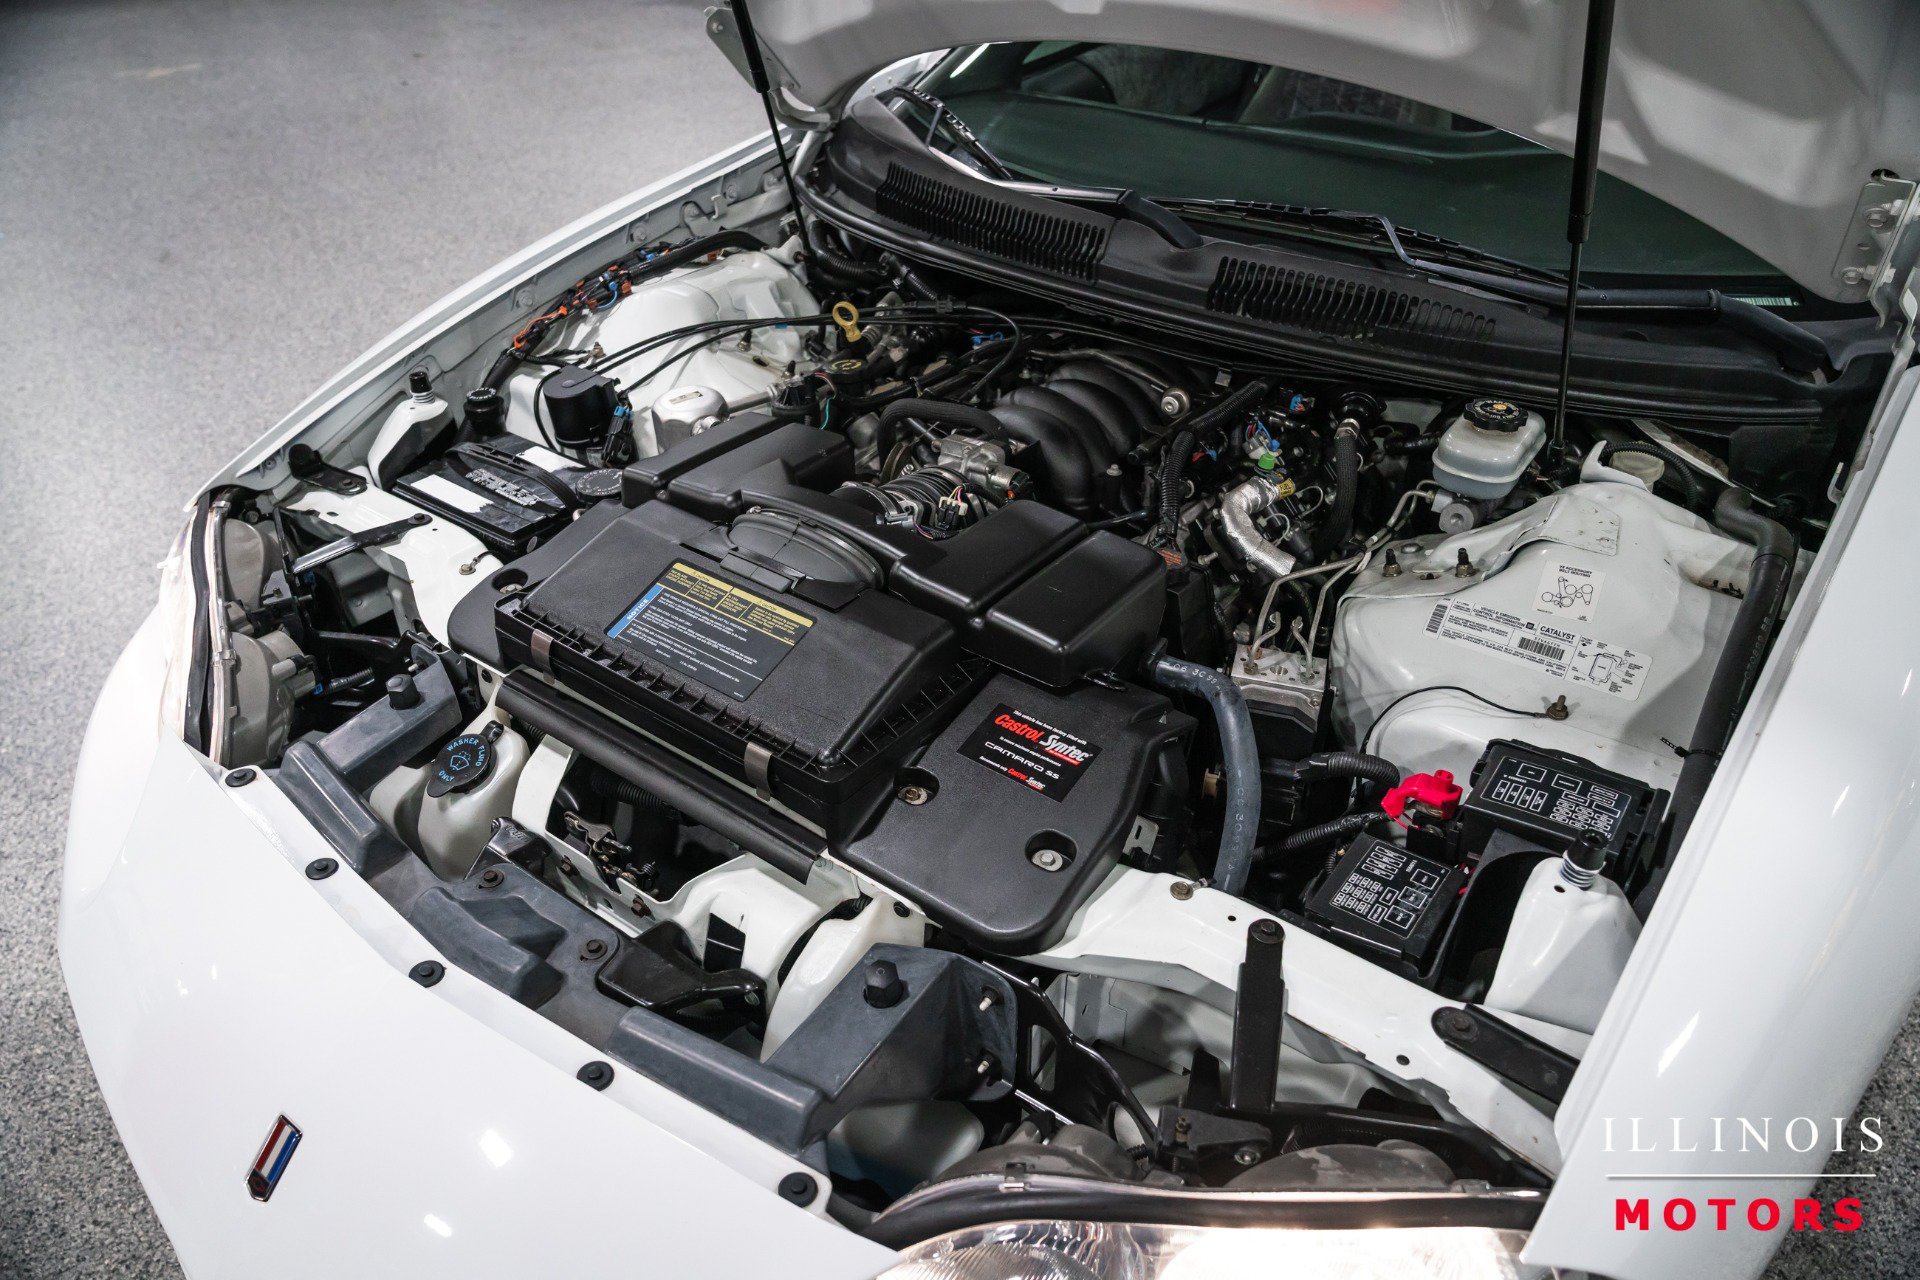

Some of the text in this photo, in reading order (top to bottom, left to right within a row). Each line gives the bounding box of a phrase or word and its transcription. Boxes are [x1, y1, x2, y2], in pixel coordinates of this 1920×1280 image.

[627, 599, 648, 620] NOTICE
[1472, 608, 1525, 627] CONTROL INFORMATION
[1480, 606, 1499, 615] VEHICLE
[1499, 612, 1521, 622] EMISSION
[1540, 626, 1576, 641] CATALYST
[1022, 714, 1036, 722] vehicle
[1052, 728, 1067, 737] factory
[447, 738, 479, 752] WASHER
[994, 714, 1045, 742] Castrol
[1039, 734, 1089, 762] Syntec
[476, 745, 486, 766] FLUID
[985, 742, 1044, 772] CAMARO
[1045, 770, 1060, 779] SS
[438, 770, 455, 782] ONLY
[1008, 768, 1028, 780] Castrol
